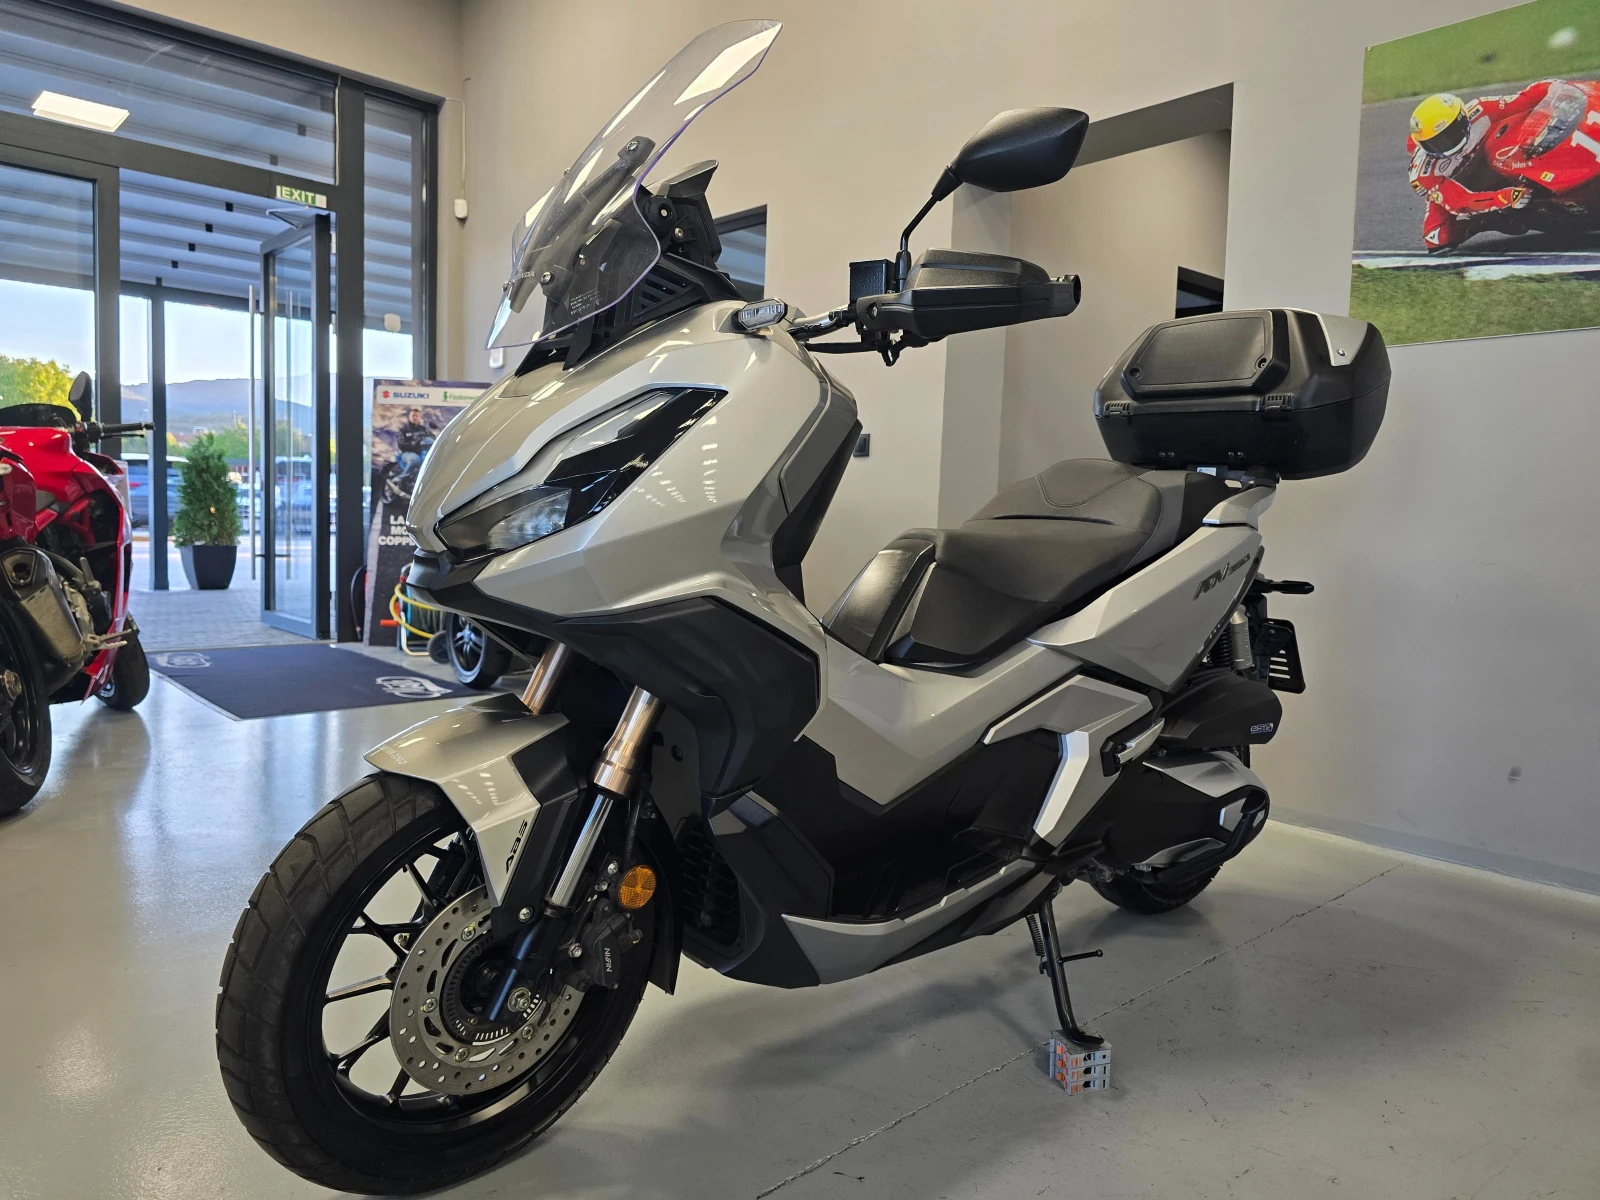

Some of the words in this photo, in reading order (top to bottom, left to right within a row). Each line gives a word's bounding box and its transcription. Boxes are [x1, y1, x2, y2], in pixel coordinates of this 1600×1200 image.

[1512, 161, 1526, 169] John
[281, 186, 315, 204] EXIT
[390, 514, 405, 525] LA
[506, 819, 527, 874] ABS
